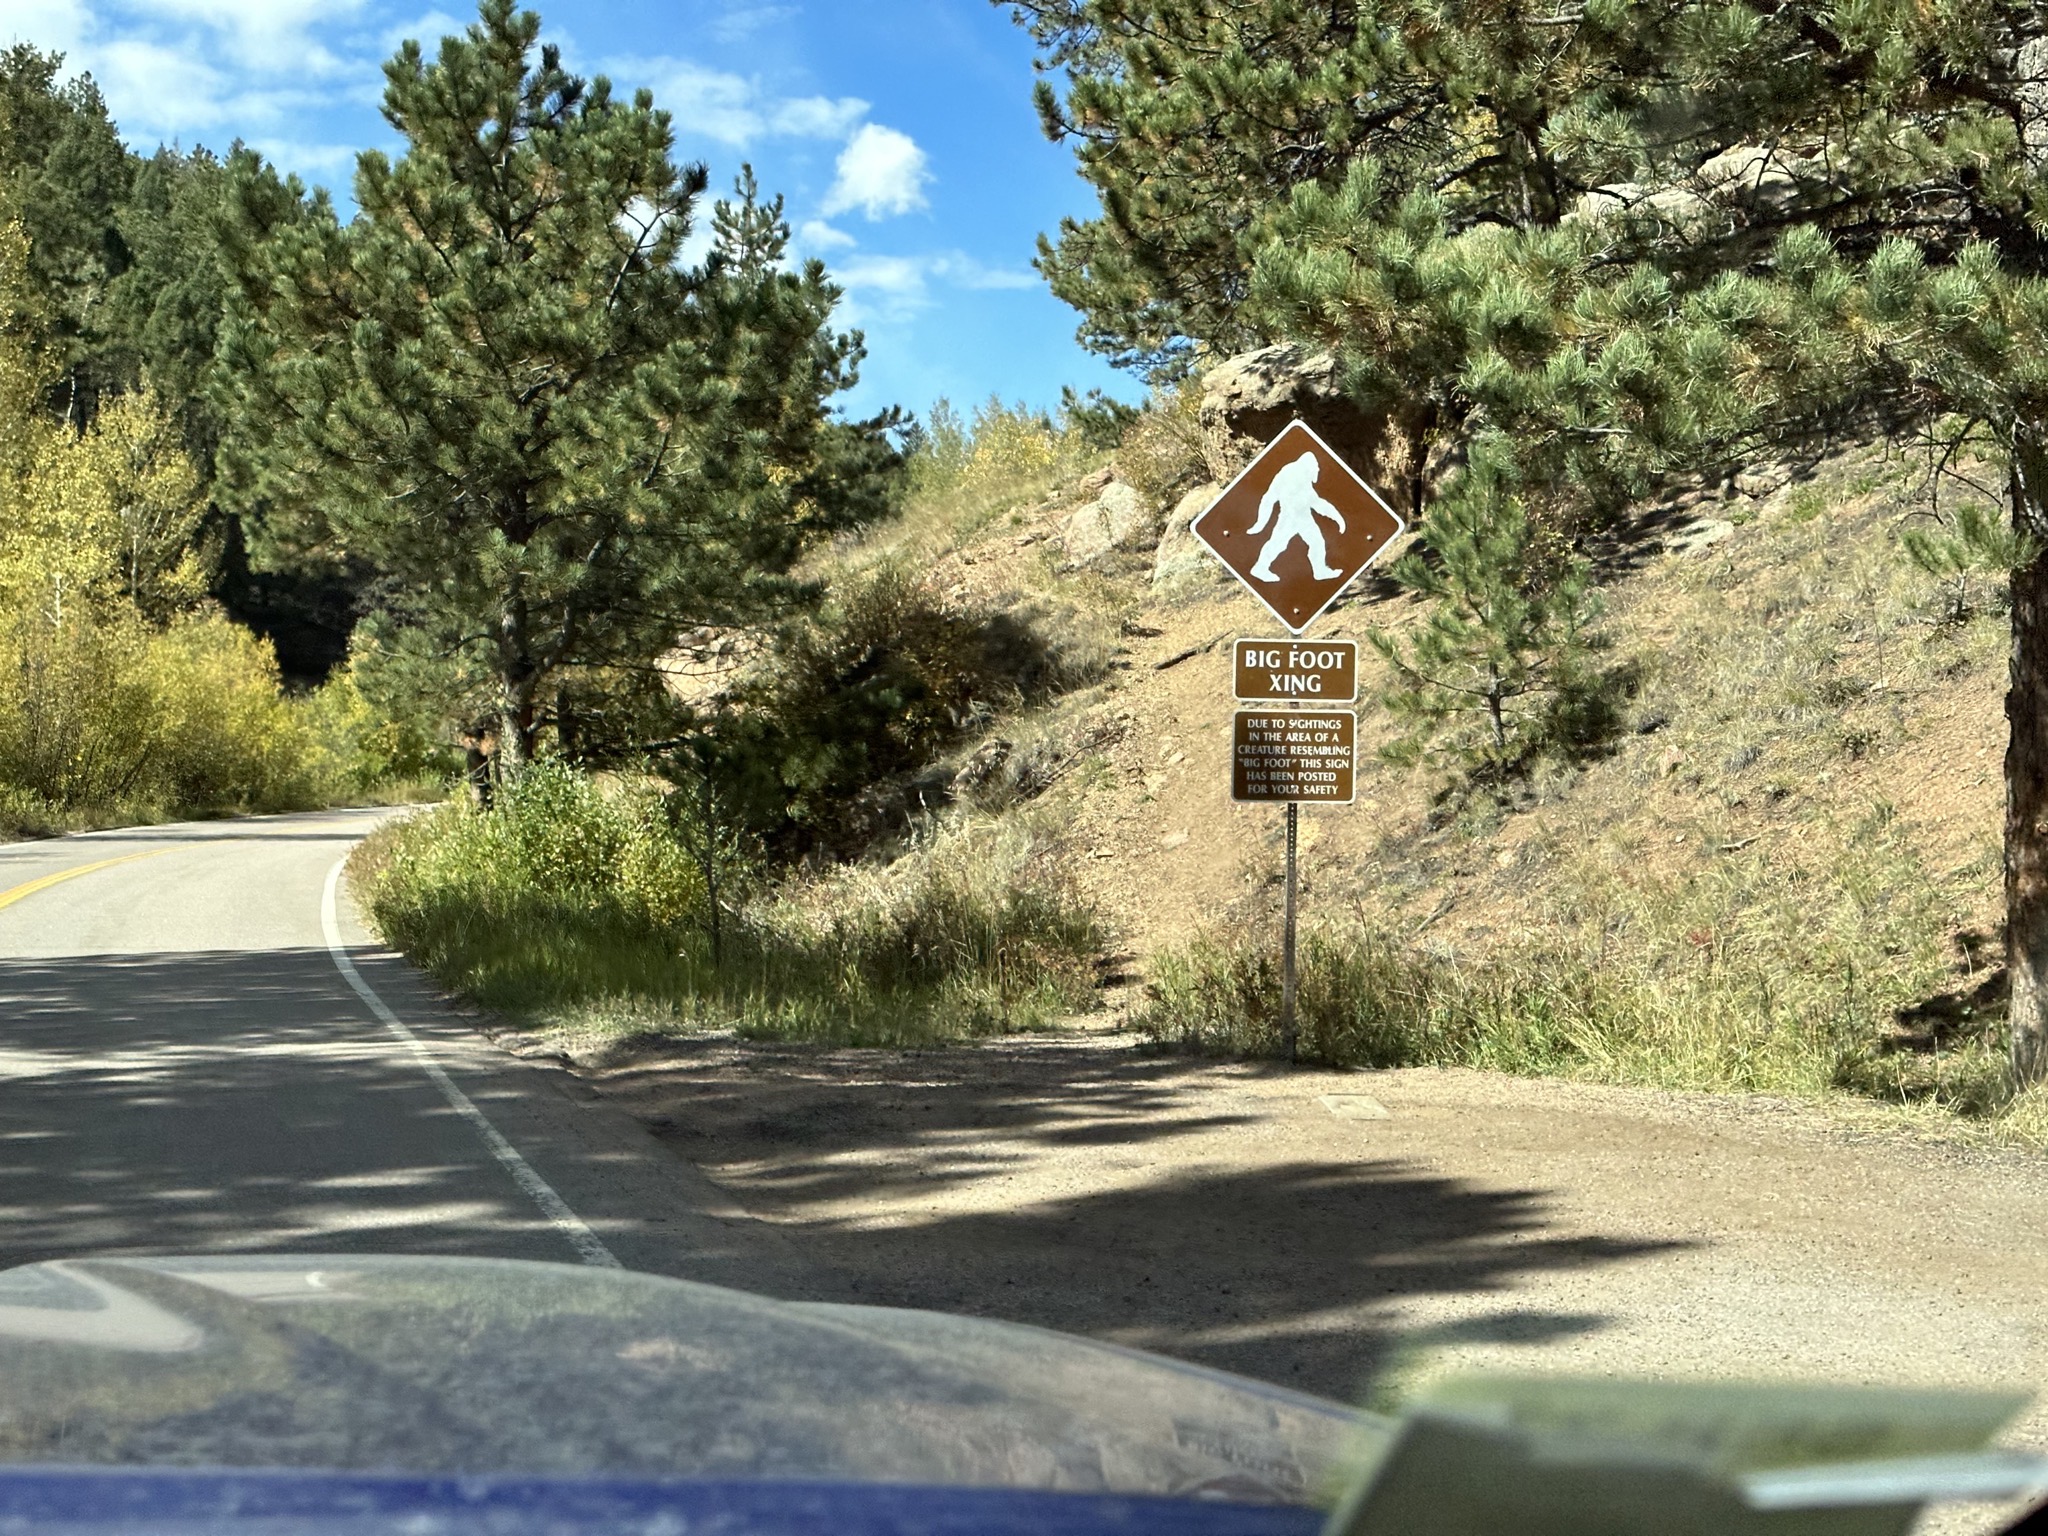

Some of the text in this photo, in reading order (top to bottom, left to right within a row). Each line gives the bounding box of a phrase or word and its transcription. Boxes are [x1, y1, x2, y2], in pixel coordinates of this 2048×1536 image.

[1245, 650, 1345, 669] BIG FOOT
[1269, 674, 1321, 692] XING
[1247, 719, 1341, 729] DUE TO SIGHTINGS
[1249, 732, 1339, 742] IN THE AREA OF A
[1238, 745, 1350, 755] CREATURE RESEMBLING
[1300, 759, 1321, 768] THIS
[1325, 759, 1349, 768] SIGN
[1247, 772, 1336, 781] HAS BEEN POSTED
[1248, 785, 1338, 794] FOR YOUR SAFETY
